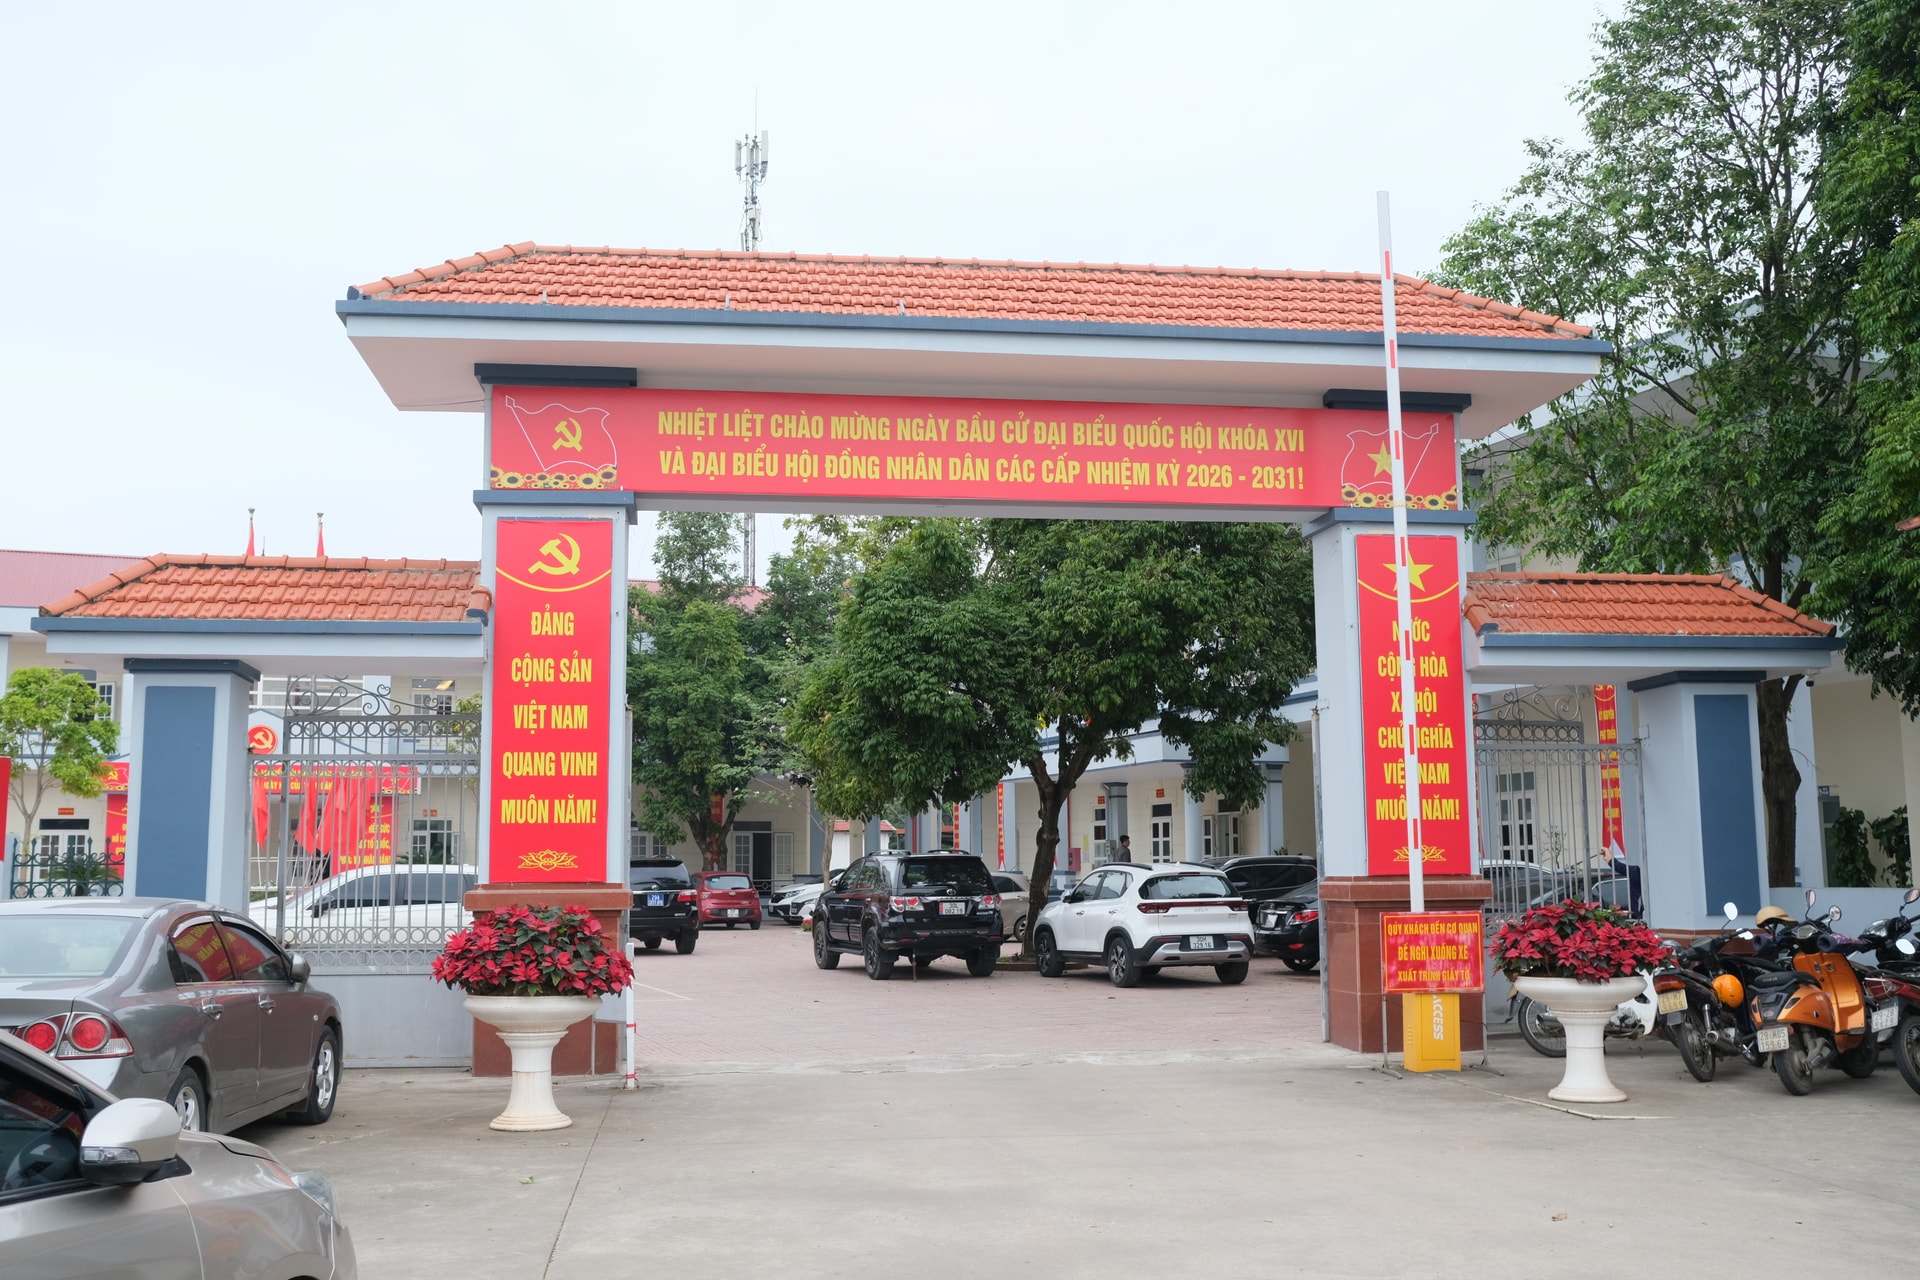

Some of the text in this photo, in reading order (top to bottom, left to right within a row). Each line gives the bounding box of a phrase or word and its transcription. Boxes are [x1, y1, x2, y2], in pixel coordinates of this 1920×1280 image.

[658, 407, 1305, 454] NHIỆT LIỆT CHÀO MỪNG NGÀY BẦU CỬ ĐẠI BIỂU QUỐC HỘI KHÓA XVI
[660, 448, 686, 474] VÀ
[692, 451, 726, 480] ĐẠI
[733, 443, 779, 477] BIỂU
[785, 449, 819, 483] HỘI
[824, 446, 880, 480] ĐỒNG
[886, 452, 942, 480] NHÂN
[949, 453, 989, 481] DÂN
[996, 453, 1036, 483] CÁC
[1042, 452, 1081, 484] CẤP
[1087, 457, 1151, 490] NHIỆM
[1156, 459, 1181, 486] KỲ
[1187, 464, 1233, 488] 2026
[1252, 466, 1304, 490] 2031!
[531, 604, 575, 636] ĐẢNG
[1392, 617, 1431, 642] NỚC
[511, 650, 592, 687] CỘNG SẢN
[1419, 651, 1448, 678] HÒA
[513, 700, 588, 734] VIỆT NAM
[1390, 687, 1438, 718] X HỘI
[502, 752, 598, 779] QUANG VINH
[1383, 758, 1450, 790] VIỆ NAM
[501, 794, 597, 824] MUÔN NĂM!
[1376, 794, 1460, 821] MUÔ NĂM!
[1458, 945, 1469, 960] XE
